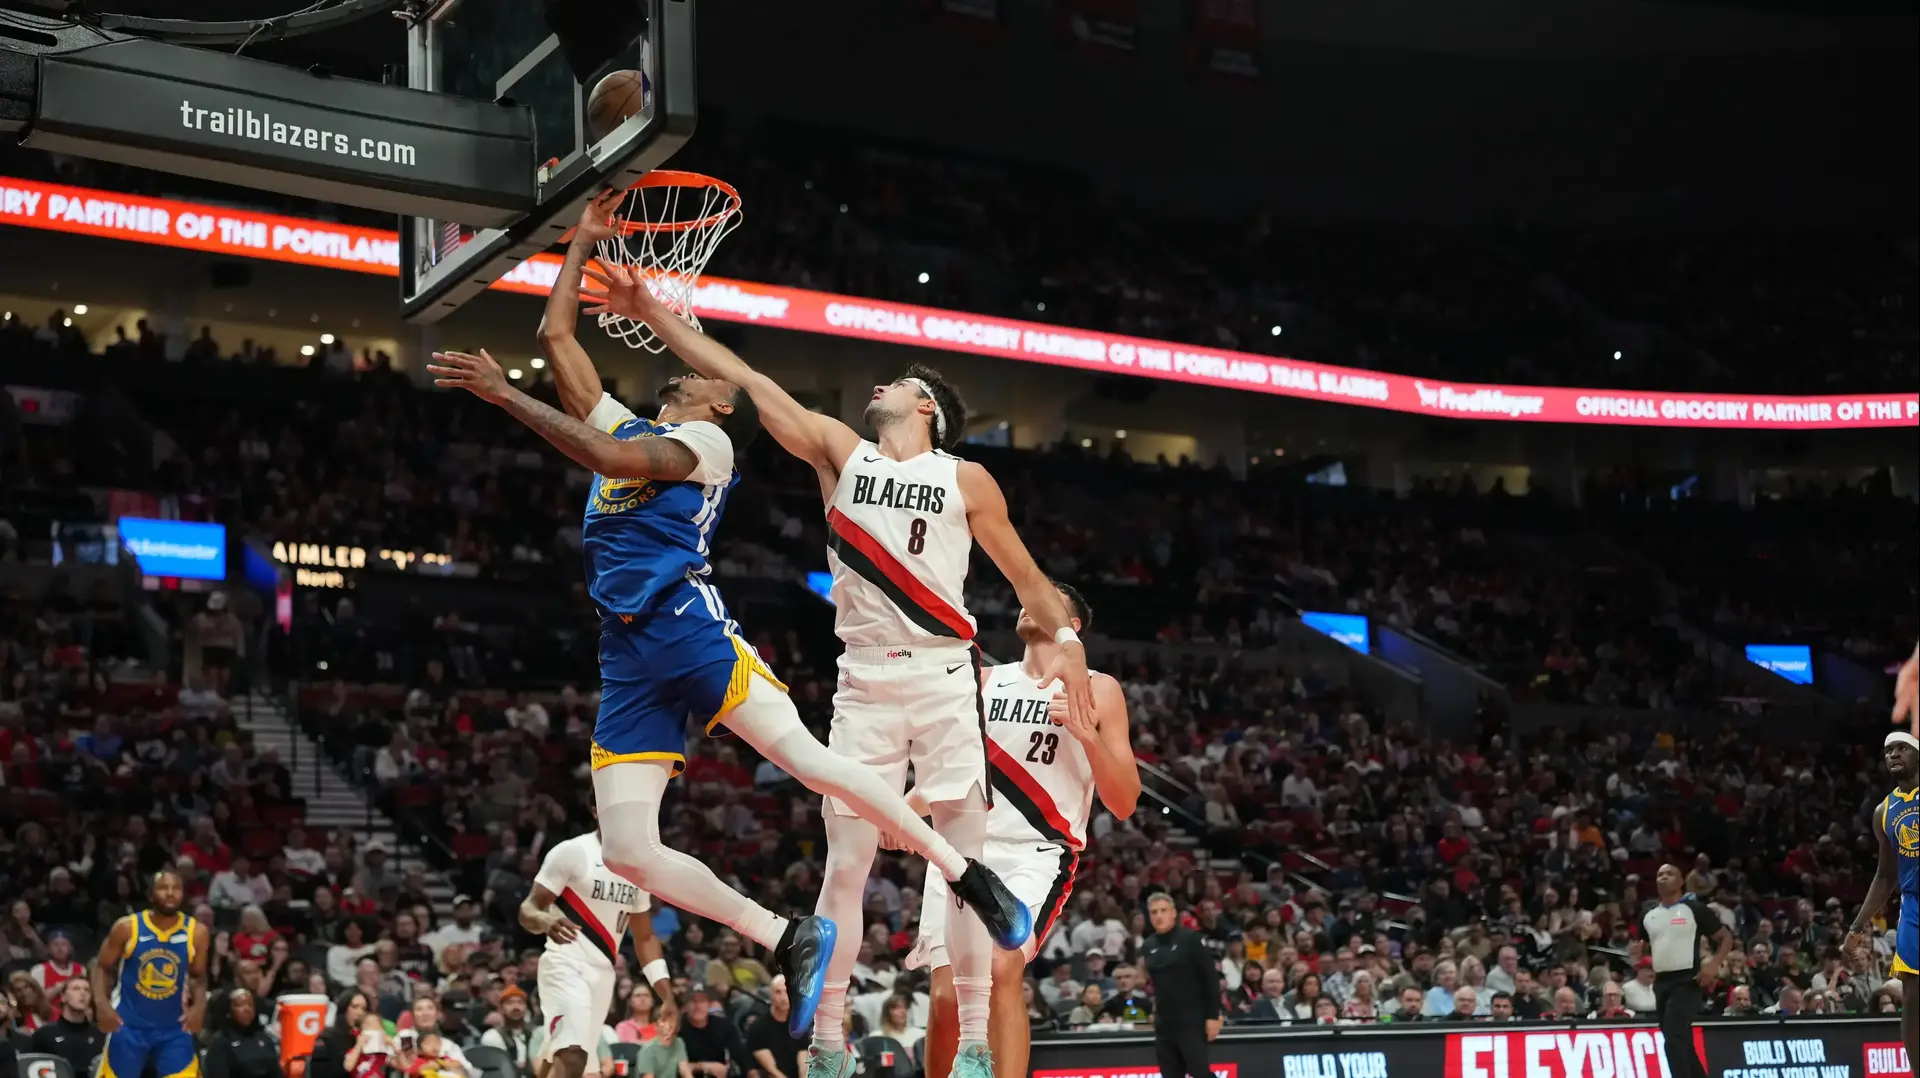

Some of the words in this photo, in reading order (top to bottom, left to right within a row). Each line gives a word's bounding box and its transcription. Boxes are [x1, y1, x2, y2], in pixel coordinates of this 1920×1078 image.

[181, 101, 416, 166] trailblazers.com
[48, 194, 170, 235] PARTNER
[175, 213, 214, 240] OF
[218, 217, 267, 249] THE
[825, 303, 921, 337] OFFICIAL
[922, 316, 1020, 350] GROCERY
[1023, 331, 1106, 363] PARTNER
[1109, 343, 1136, 366] OF
[1137, 346, 1172, 372] THE
[1174, 352, 1269, 384] PORTLAND
[1270, 365, 1318, 391] TRAIL
[1319, 372, 1389, 401] BLAZERS
[1576, 396, 1658, 418] OFFICIAL
[1661, 399, 1749, 420] GROCERY
[1753, 402, 1832, 422] PARTNER
[1837, 402, 1863, 420] OF
[1867, 401, 1901, 420] THE
[593, 486, 656, 514] WARRIORS
[853, 475, 946, 514] BLAZERS
[908, 518, 927, 555] 8
[273, 541, 366, 568] AIMLER
[887, 649, 912, 659] ripcity
[988, 698, 1063, 727] BLAZER
[1026, 731, 1059, 765] 23
[298, 1010, 320, 1036] G
[1283, 1054, 1338, 1078] BUILD
[1339, 1052, 1388, 1078] YOUR
[1743, 1041, 1787, 1065] BUILD
[1787, 1039, 1826, 1064] YOUR
[1868, 1047, 1911, 1074] BUILD
